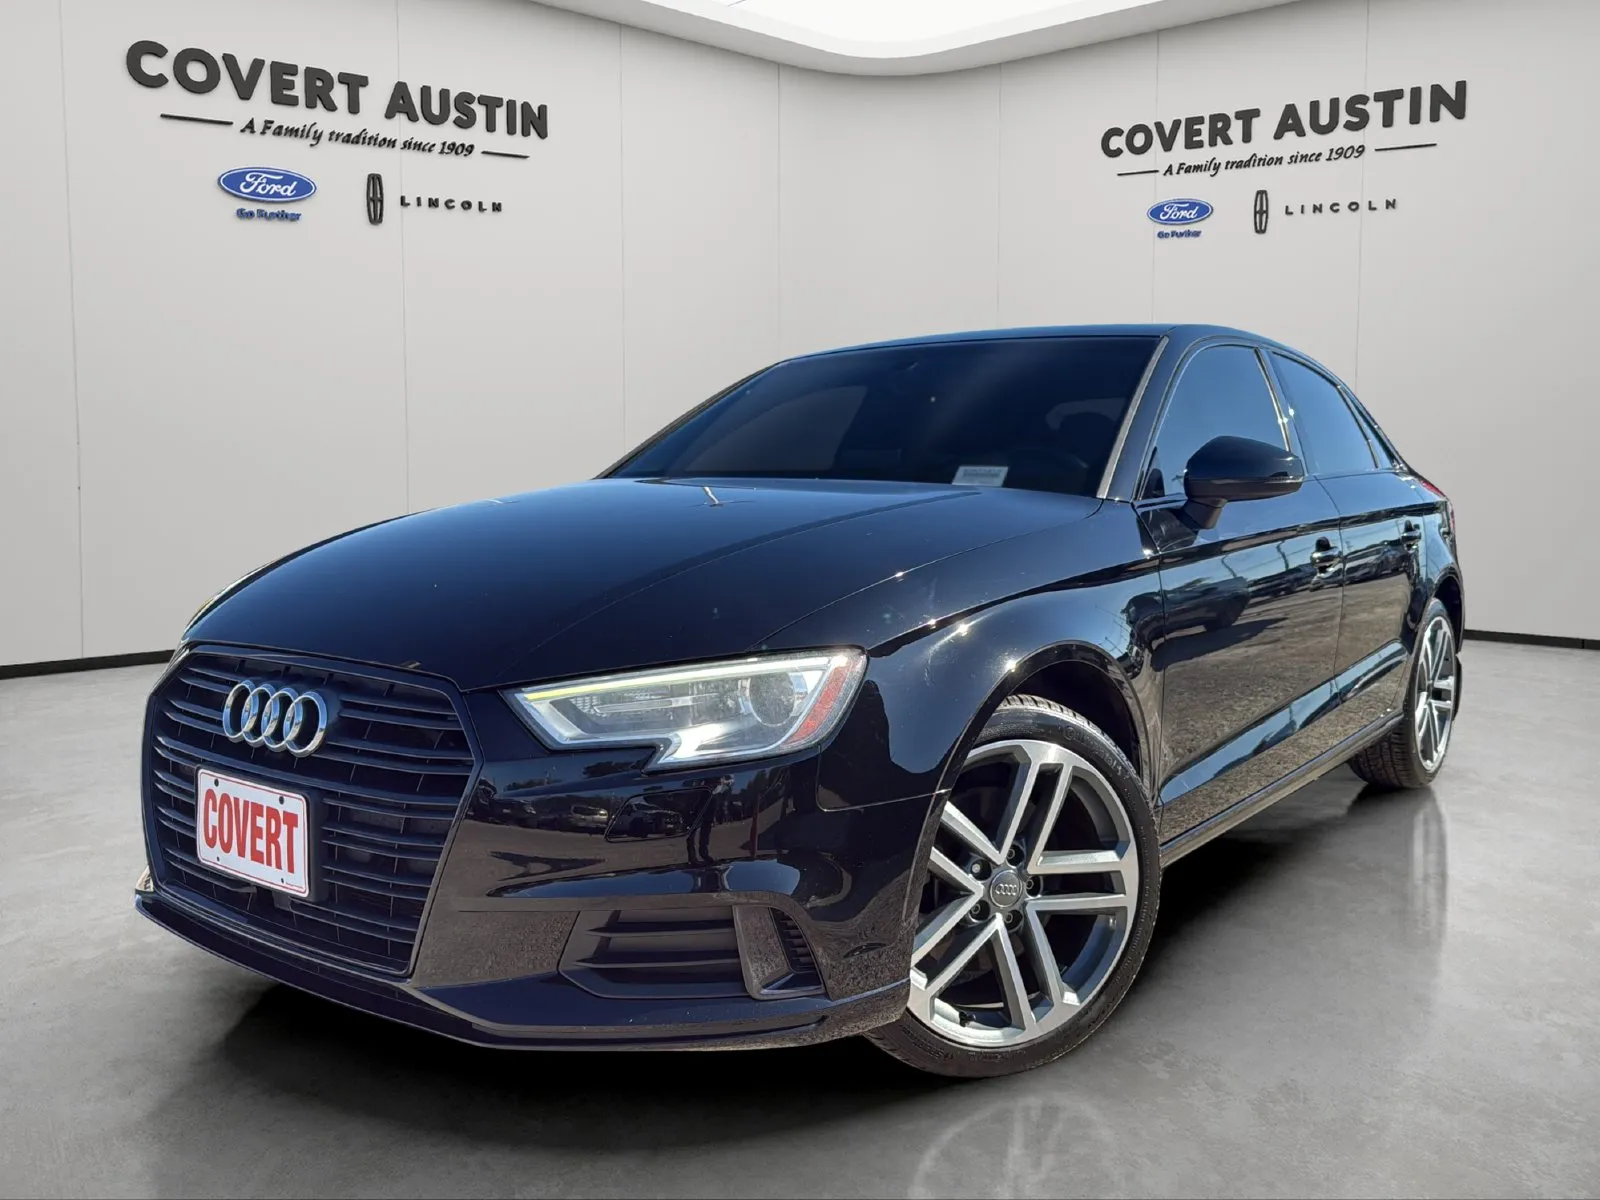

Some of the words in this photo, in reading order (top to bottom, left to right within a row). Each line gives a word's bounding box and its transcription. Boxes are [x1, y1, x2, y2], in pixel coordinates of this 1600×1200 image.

[126, 40, 369, 114] COVERT
[384, 81, 549, 140] AUSTIN
[1101, 107, 1260, 158] COVERT
[1273, 80, 1467, 140] AUSTIN
[240, 117, 256, 134] A
[259, 119, 324, 147] Family
[328, 128, 398, 149] tradition
[400, 137, 437, 153] since
[438, 140, 475, 157] 1909
[1163, 164, 1173, 177] A
[1176, 157, 1222, 178] Family
[1224, 152, 1284, 170] tradition
[1287, 150, 1323, 165] since
[1325, 144, 1366, 162] 1909
[239, 172, 298, 197] Ford
[400, 195, 502, 213] LINCOLN
[1159, 203, 1199, 220] Ford
[1284, 199, 1397, 215] LINCOLN
[203, 788, 299, 875] COVERT
